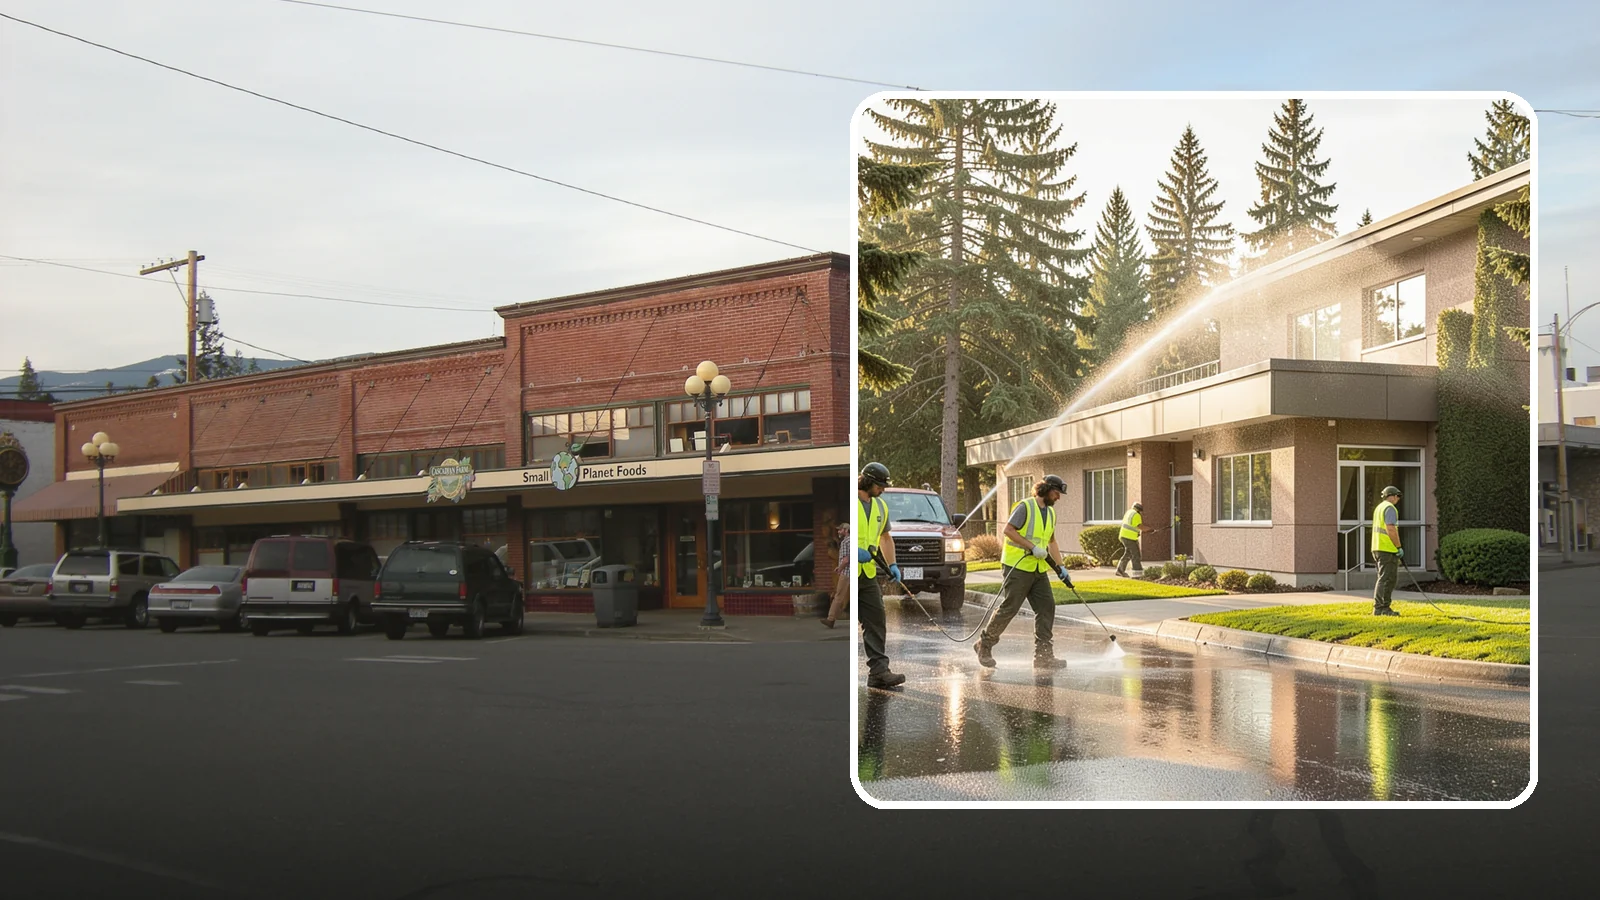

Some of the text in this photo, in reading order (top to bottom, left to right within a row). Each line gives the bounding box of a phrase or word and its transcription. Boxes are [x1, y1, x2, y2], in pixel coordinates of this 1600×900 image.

[523, 465, 647, 483] Small Planet Foods
